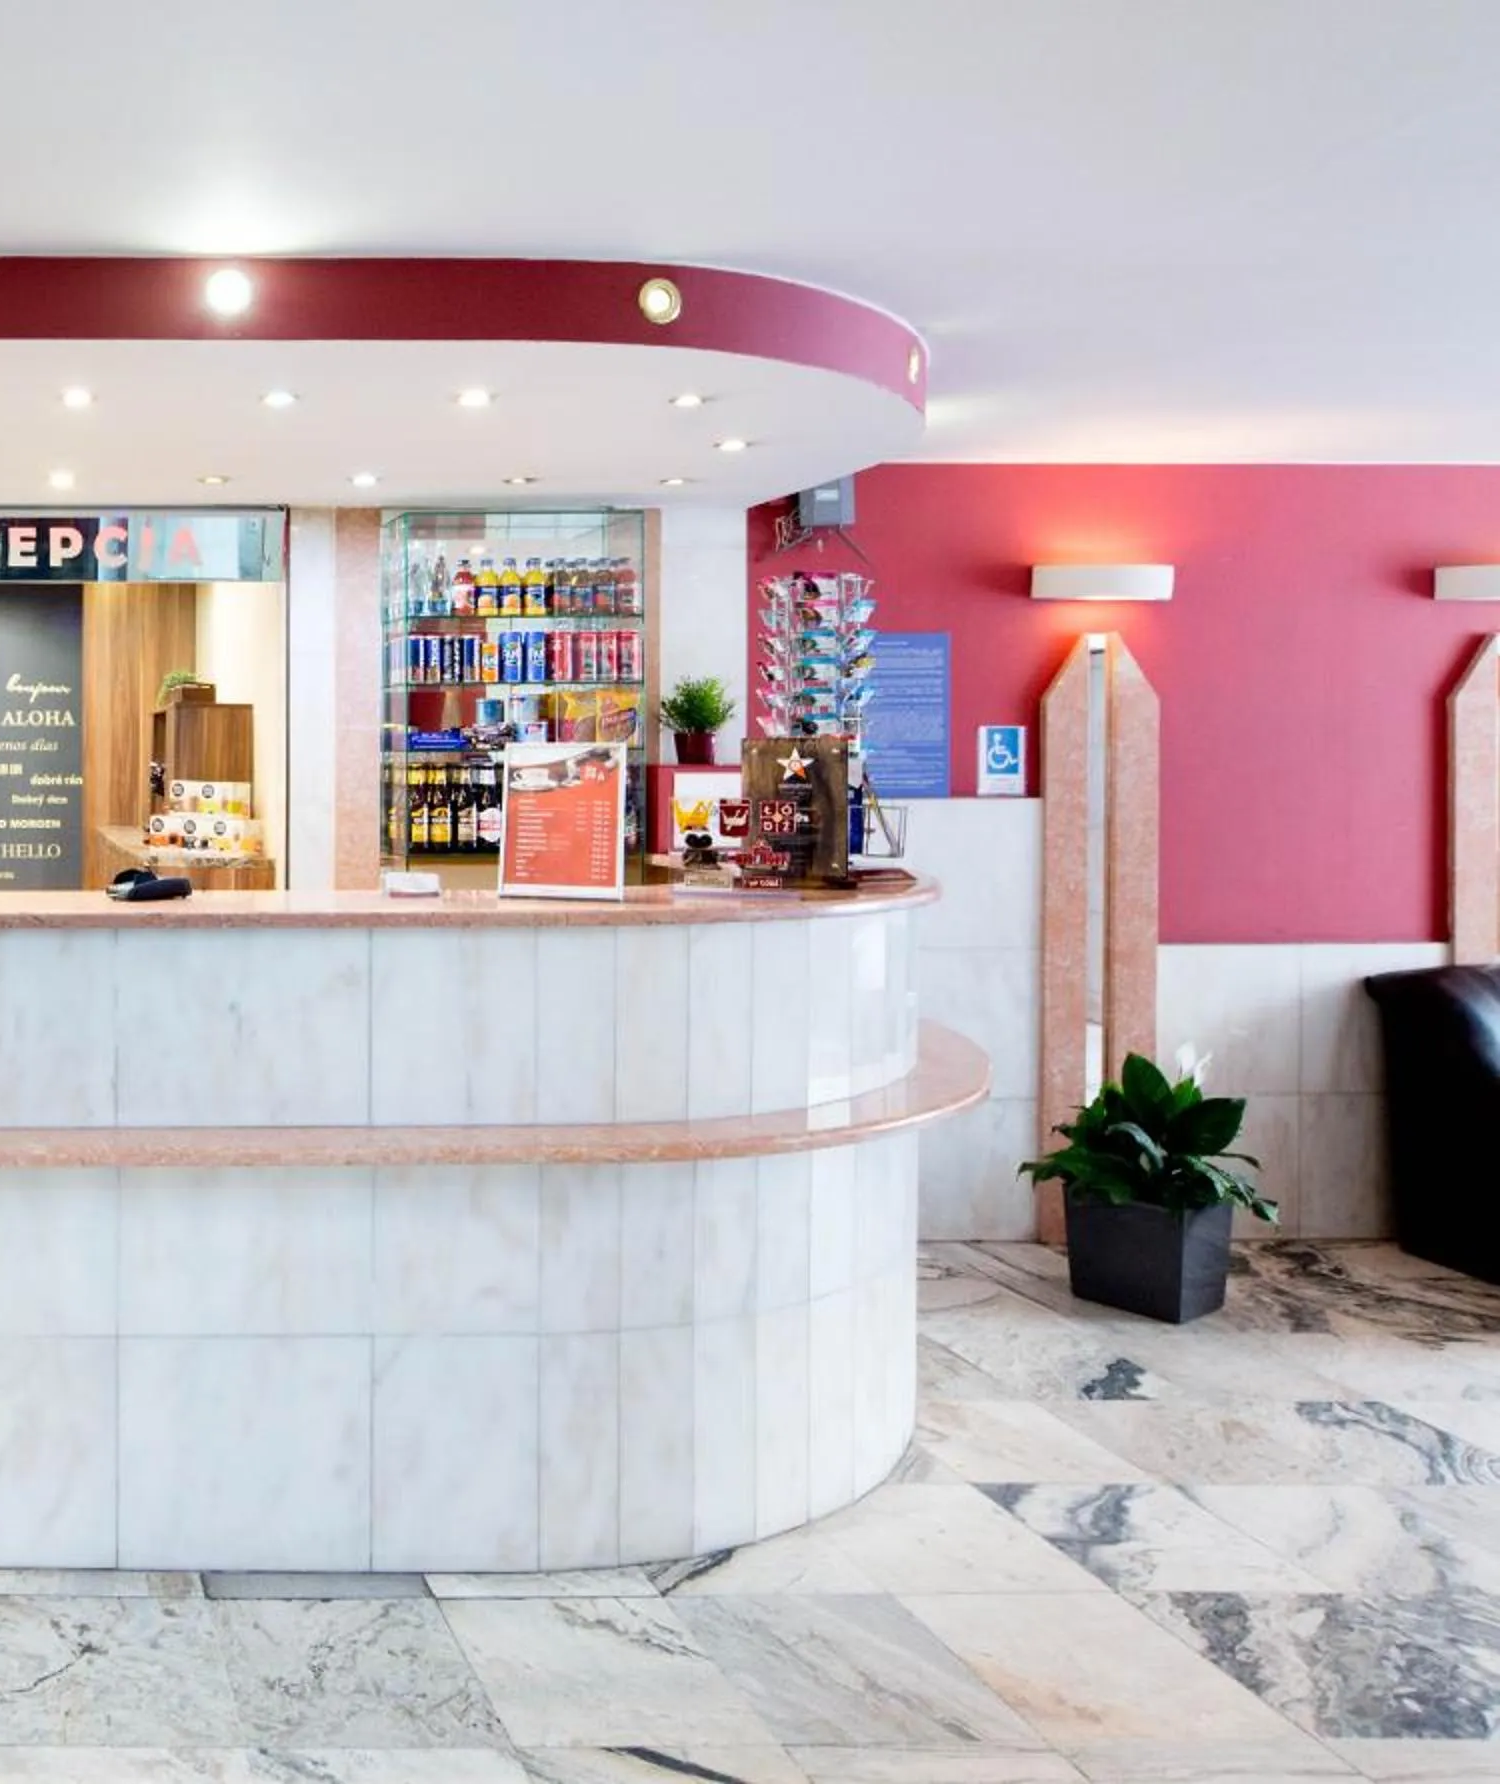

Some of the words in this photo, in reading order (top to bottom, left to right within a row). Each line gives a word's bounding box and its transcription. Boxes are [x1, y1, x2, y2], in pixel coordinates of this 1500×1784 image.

[1, 710, 76, 727] ALOHA
[63, 772, 83, 785] rán
[1, 843, 62, 859] HELLO
